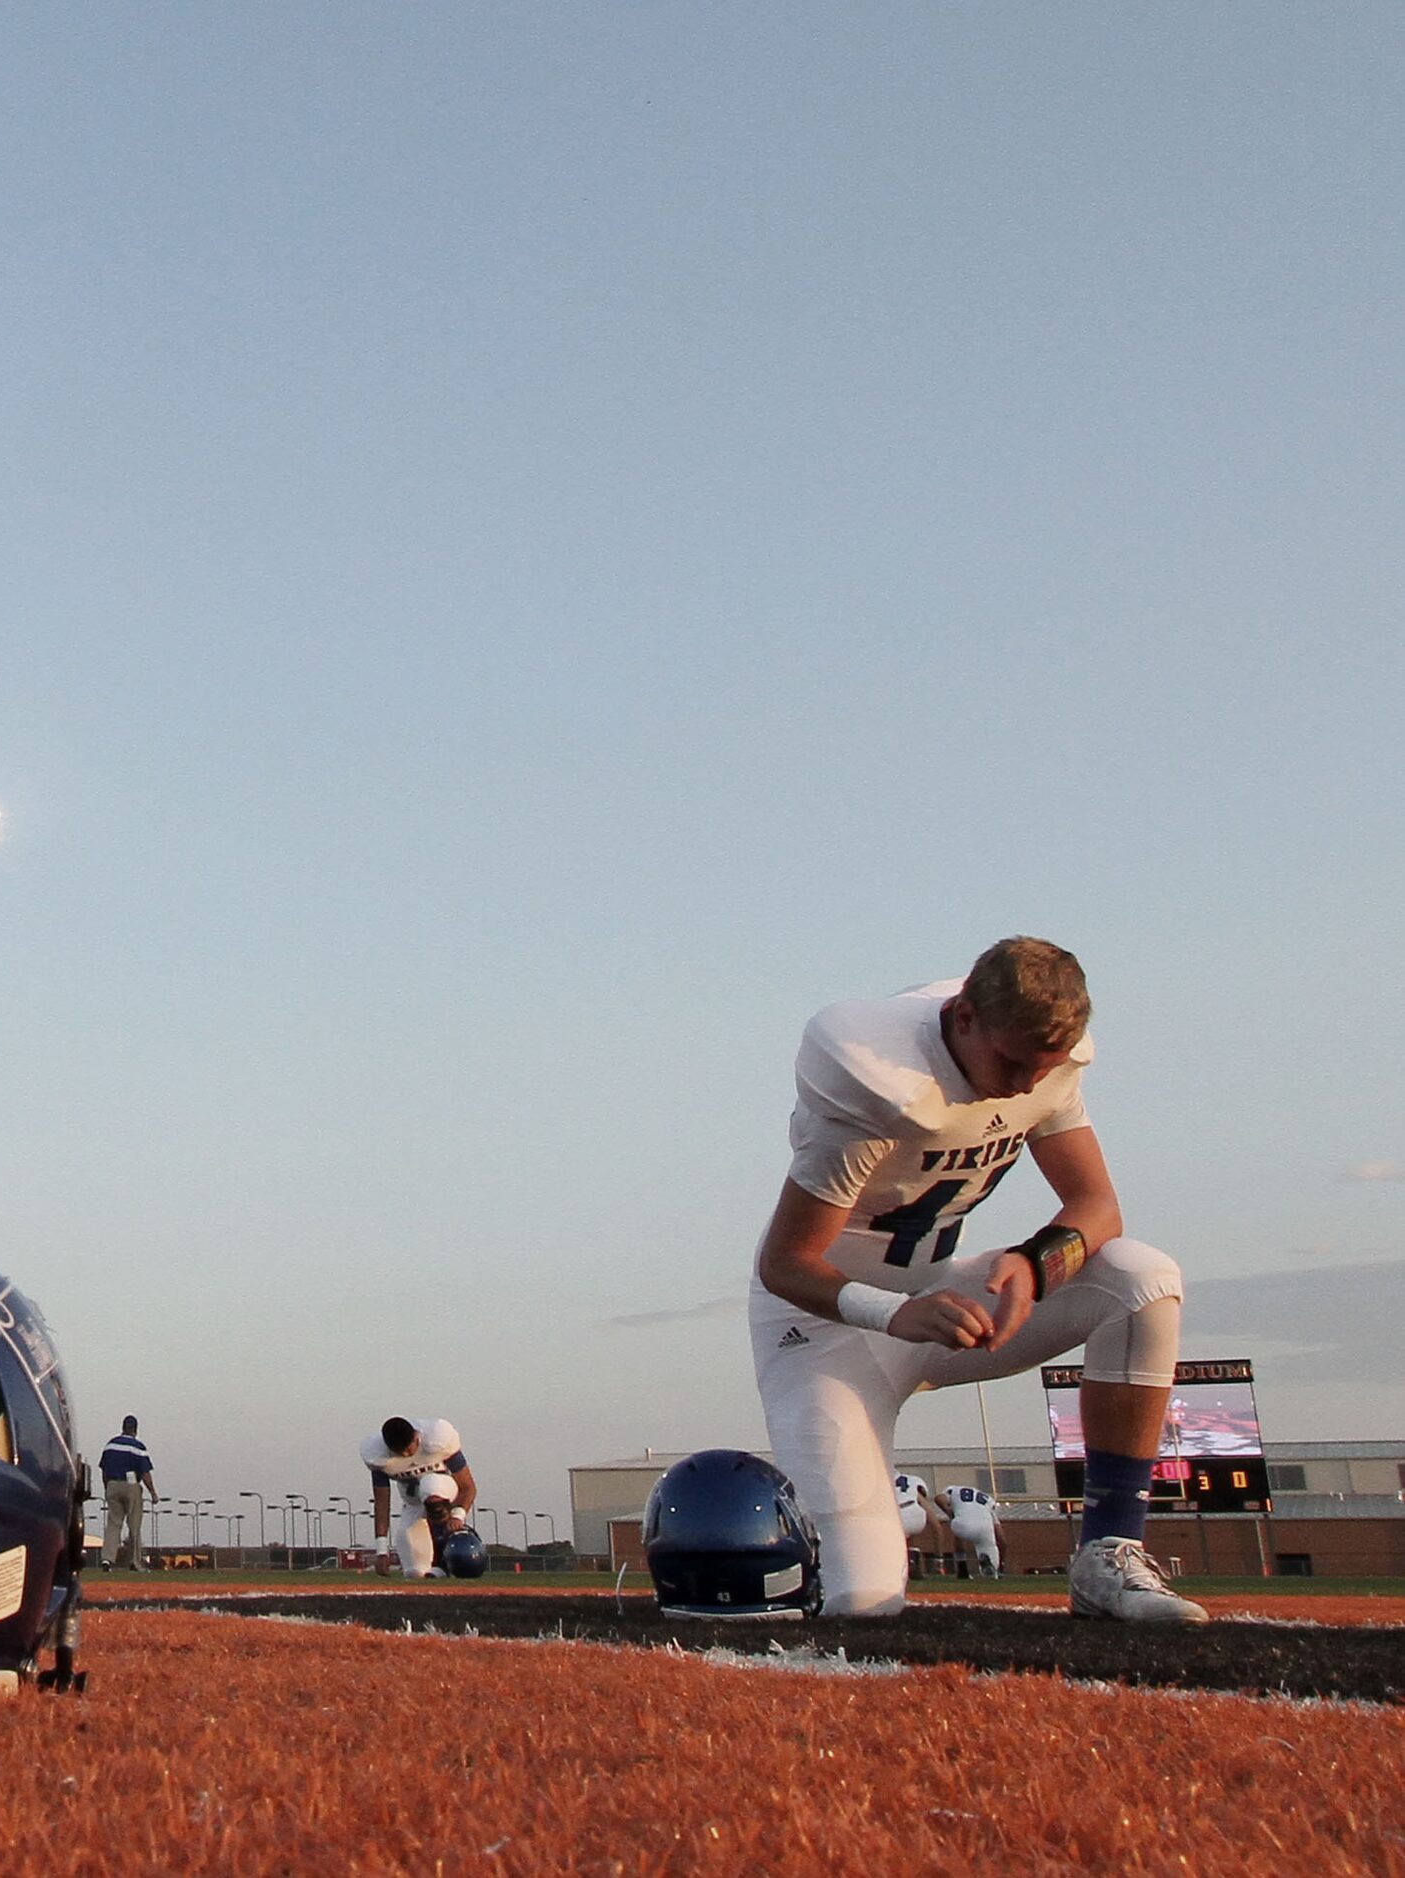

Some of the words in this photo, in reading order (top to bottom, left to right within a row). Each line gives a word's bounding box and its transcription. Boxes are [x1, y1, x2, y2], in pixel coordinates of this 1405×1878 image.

[1177, 1363, 1252, 1381] DIUM
[1198, 1475, 1210, 1491] 3
[1232, 1471, 1247, 1488] 0
